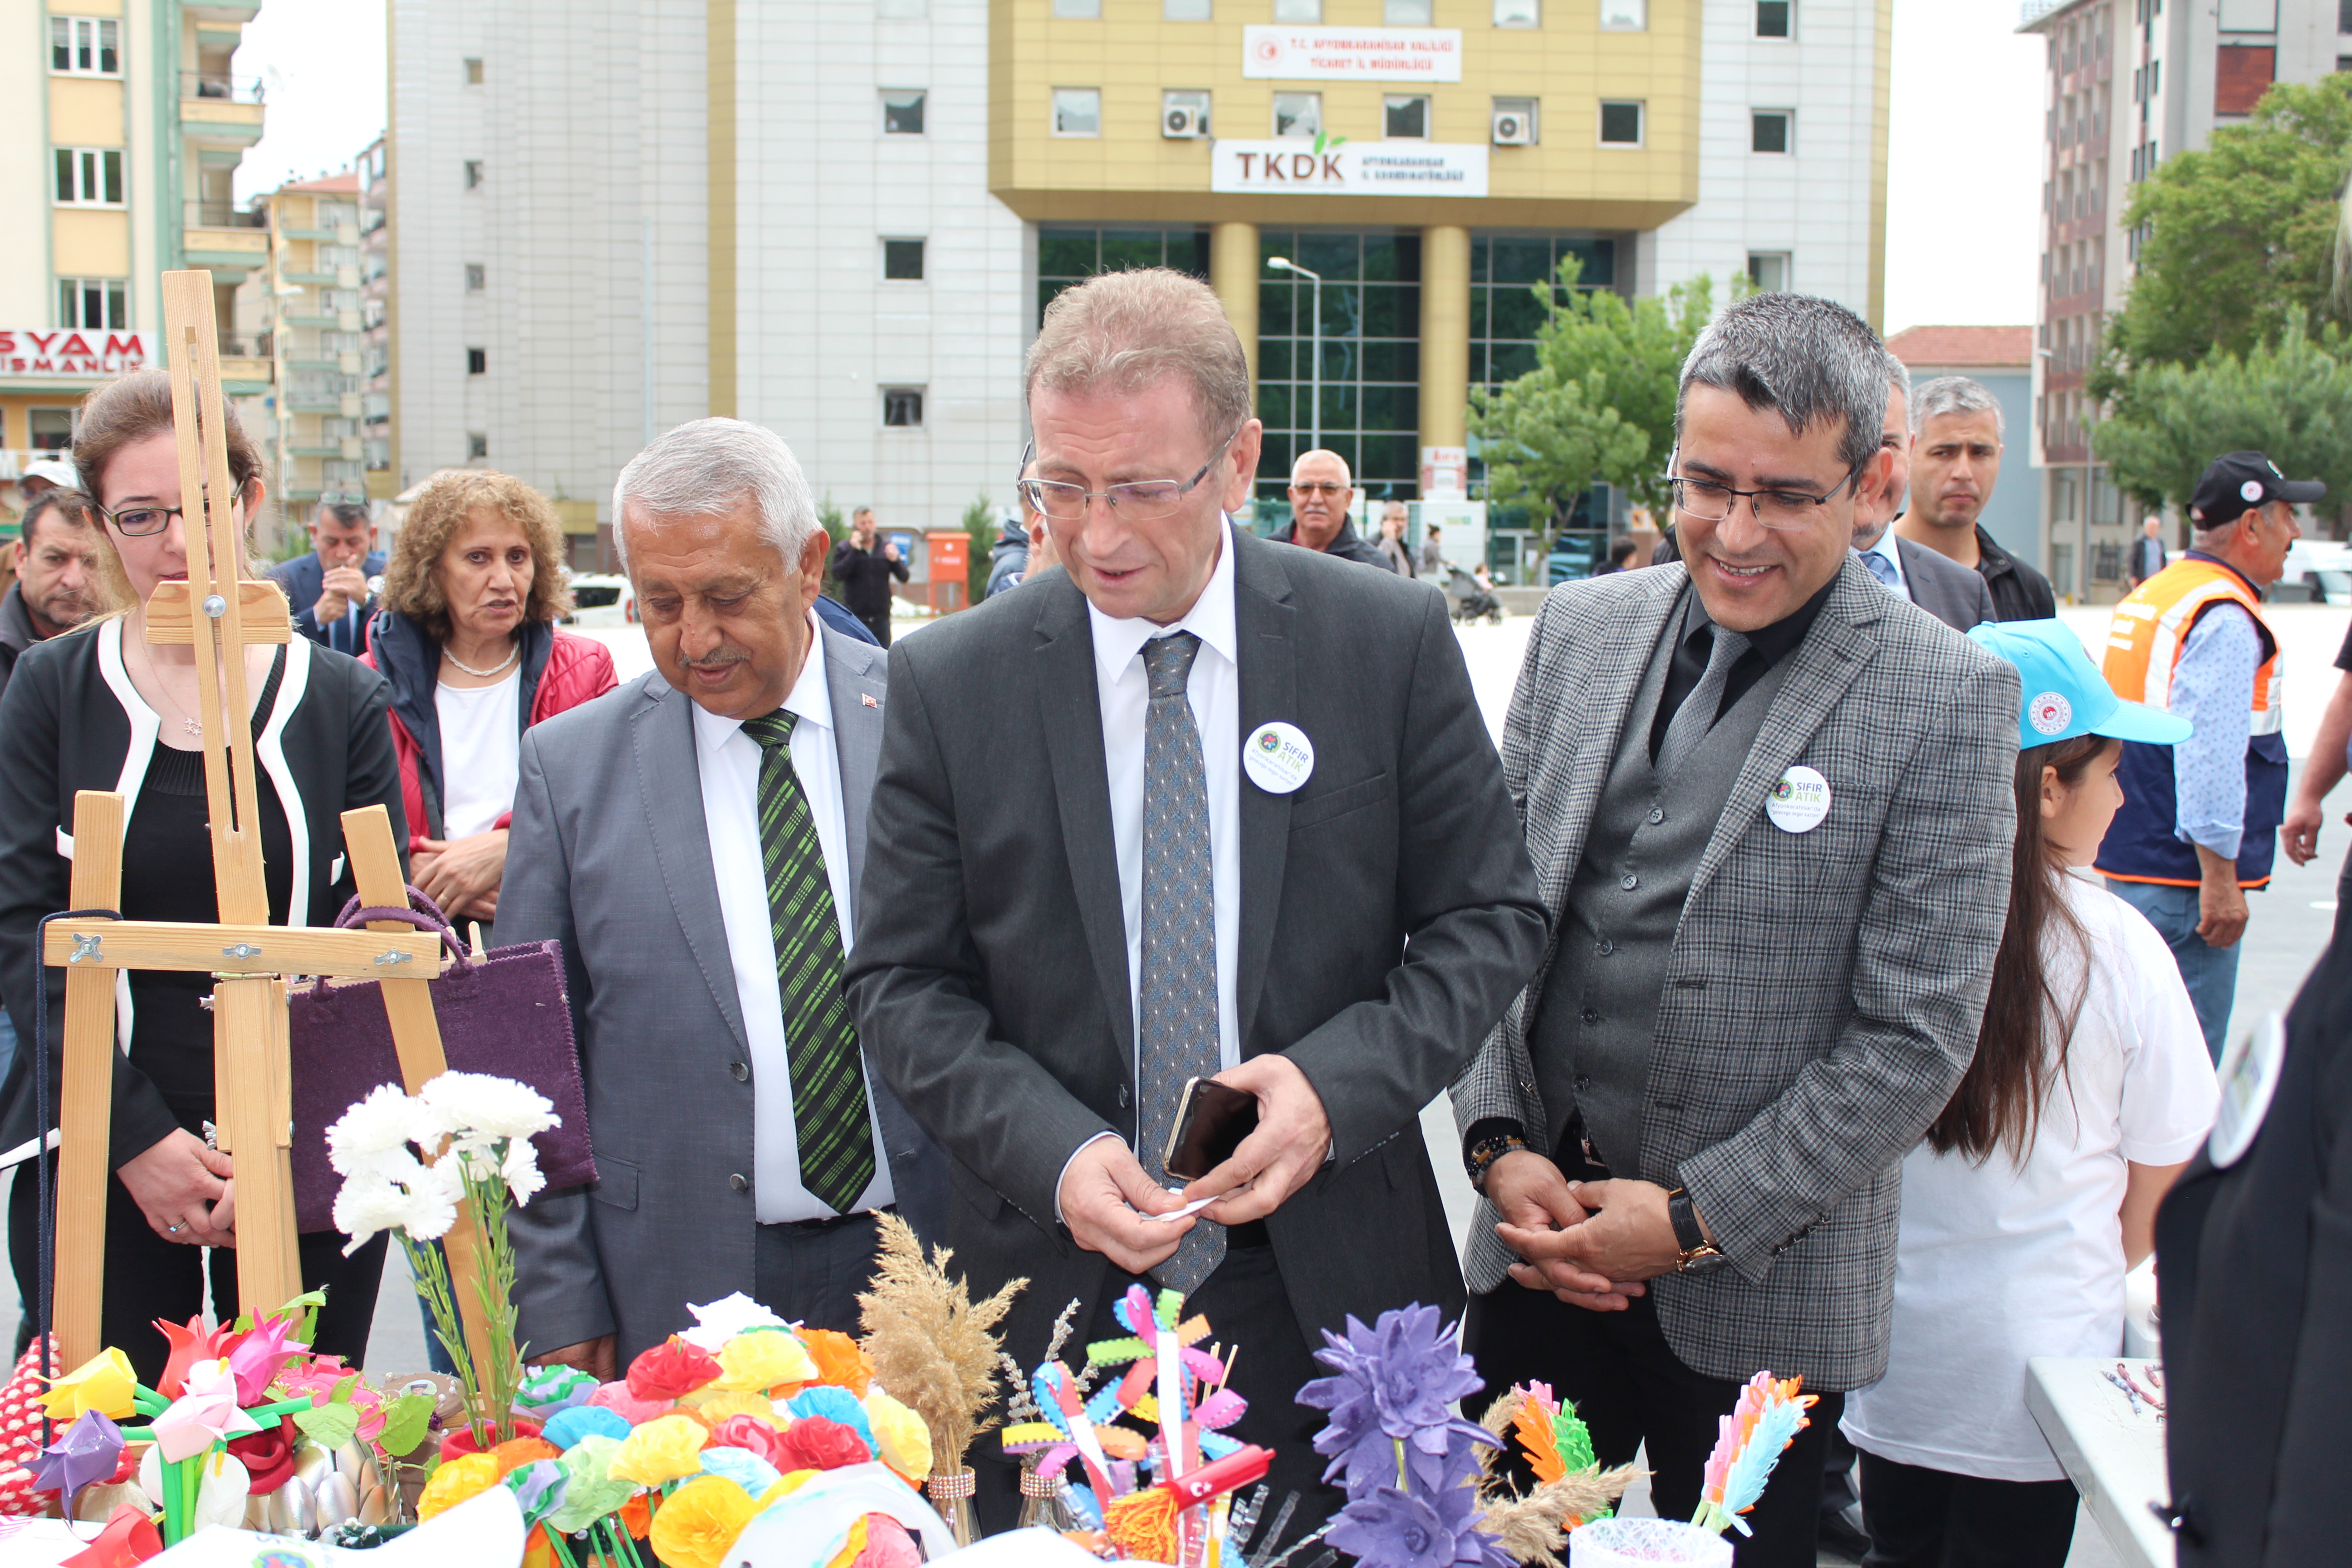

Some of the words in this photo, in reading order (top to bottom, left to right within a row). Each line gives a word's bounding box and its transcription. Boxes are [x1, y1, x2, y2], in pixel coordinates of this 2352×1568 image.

[1236, 152, 1343, 180] TKDK
[1277, 751, 1303, 772] ATIK
[1283, 742, 1308, 763] SIFIR
[1795, 792, 1821, 803] ATIK
[1796, 782, 1823, 792] SIFIR
